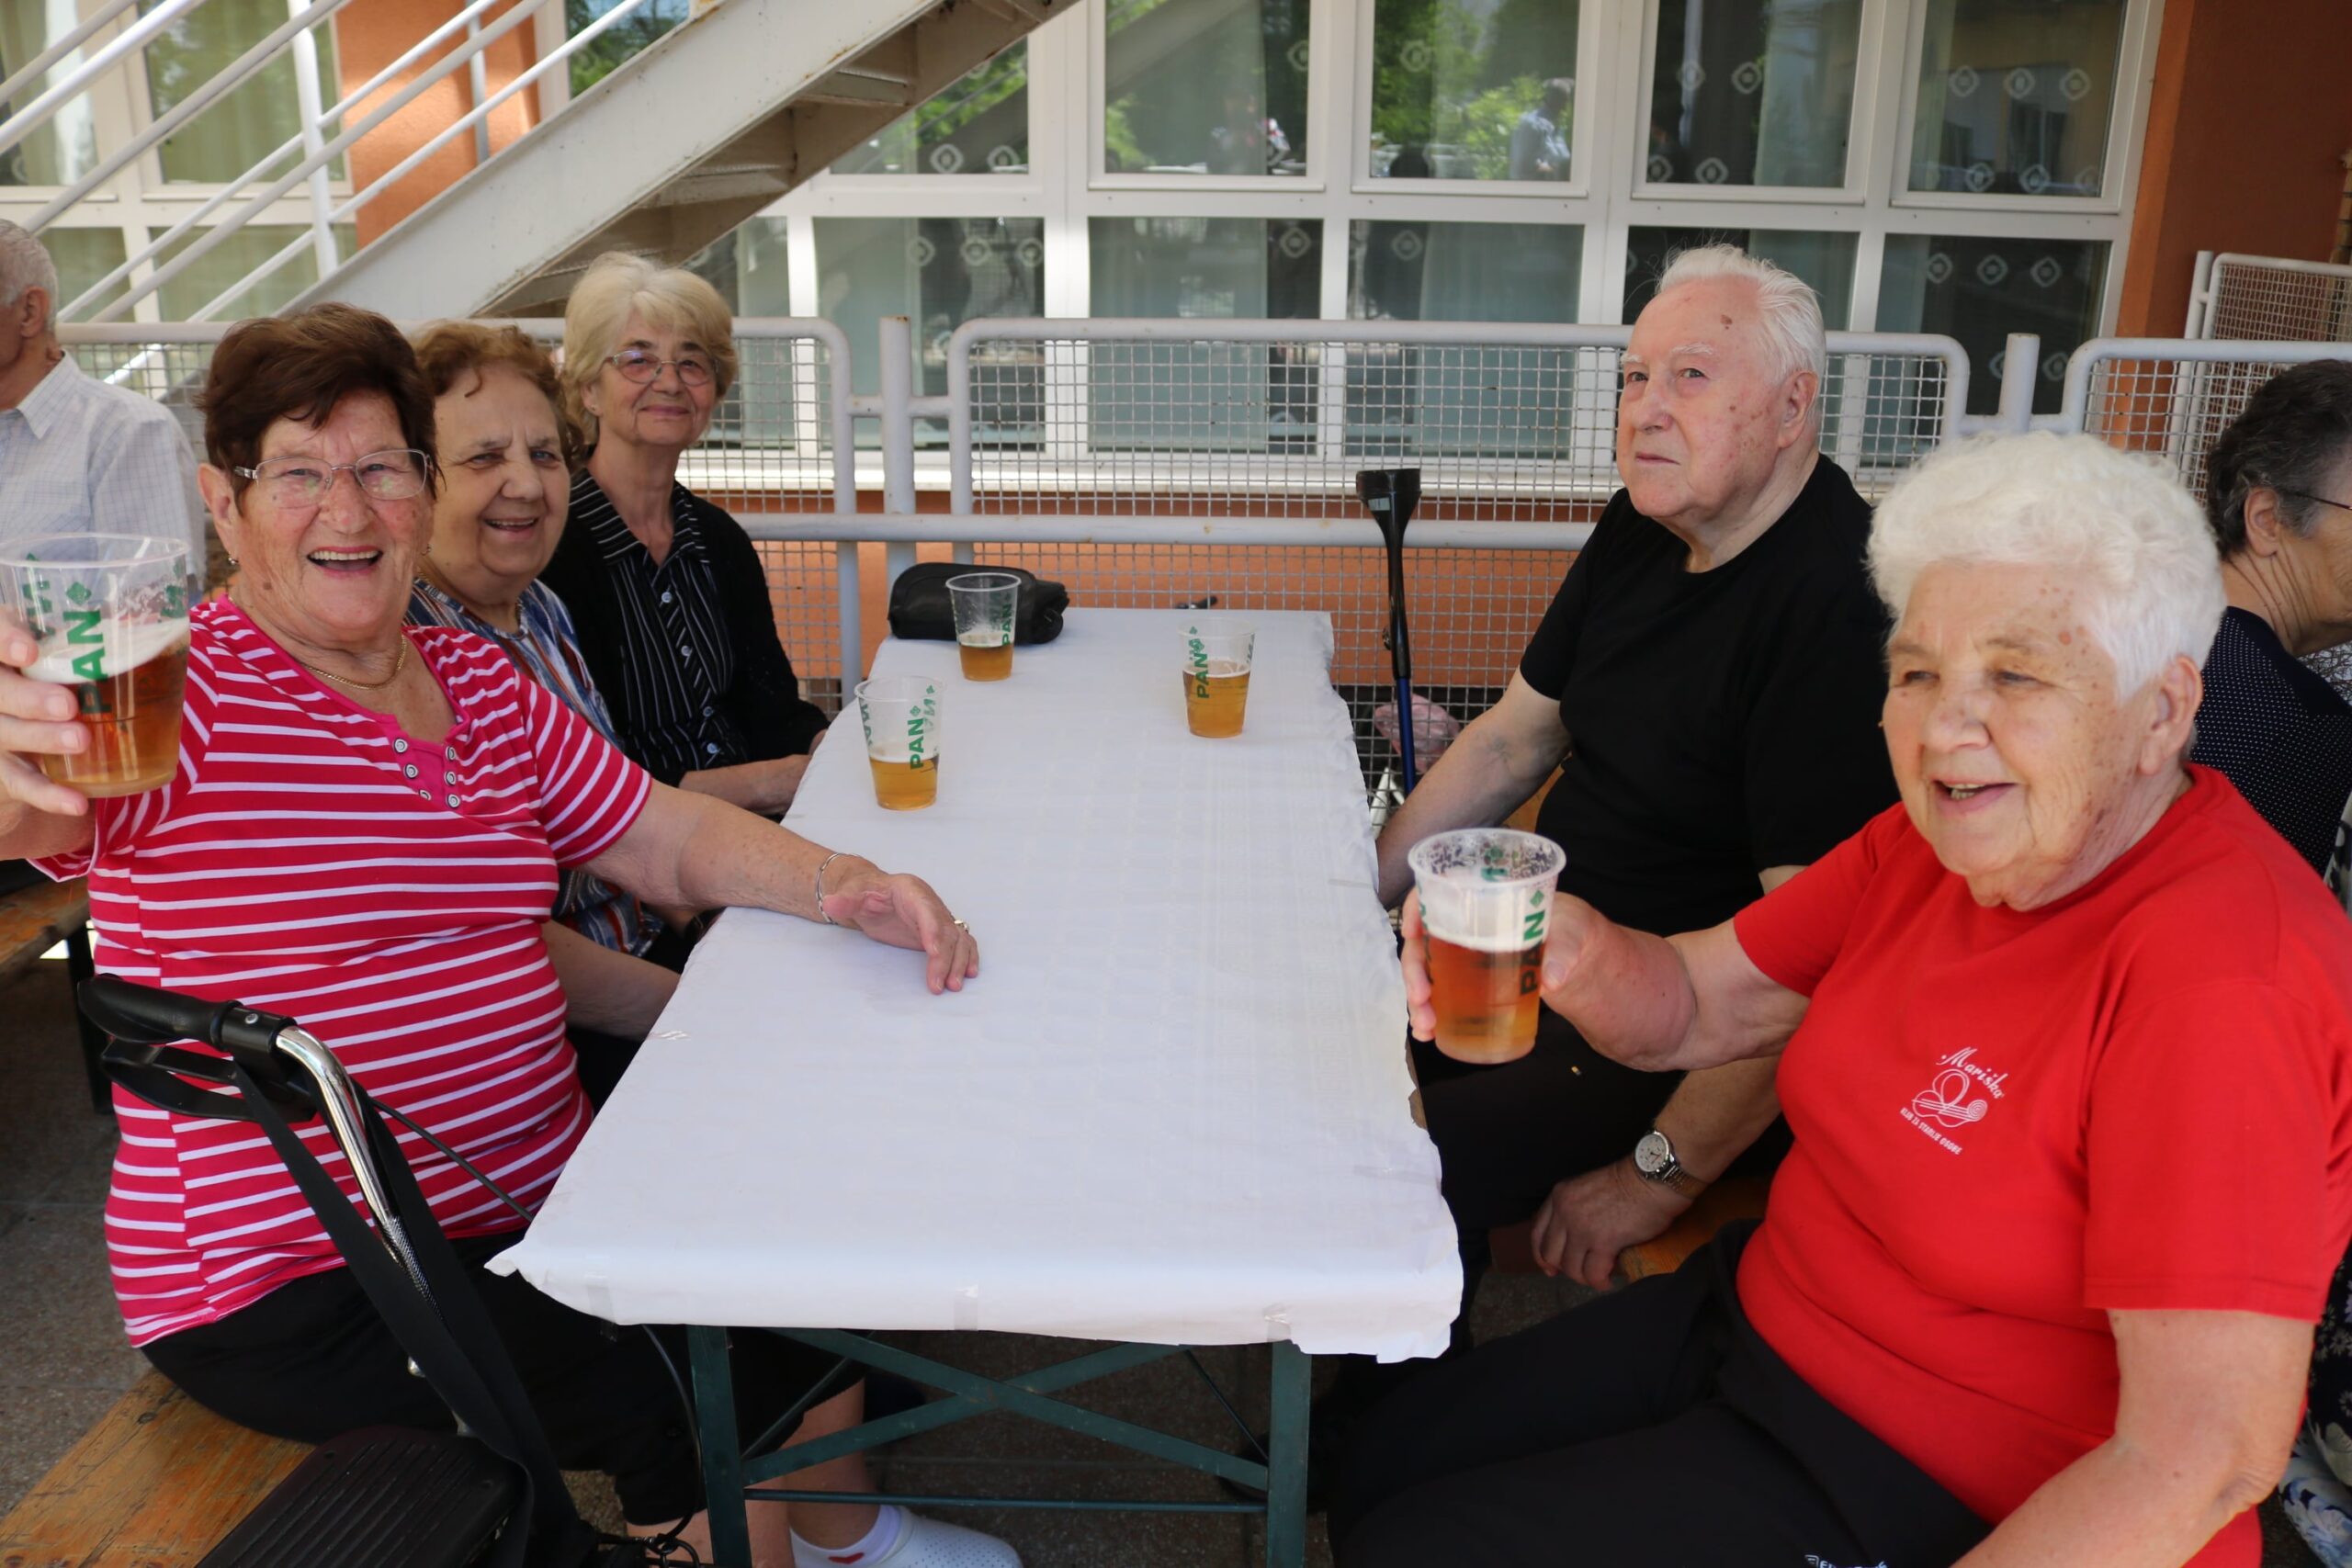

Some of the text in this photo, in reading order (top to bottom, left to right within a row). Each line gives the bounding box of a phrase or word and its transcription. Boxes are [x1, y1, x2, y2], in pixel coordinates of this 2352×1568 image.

[1001, 603, 1012, 646] PAN
[62, 609, 111, 715] PAN
[1193, 653, 1210, 699] PAN
[908, 718, 924, 770] PAN
[1520, 908, 1545, 997] PAN
